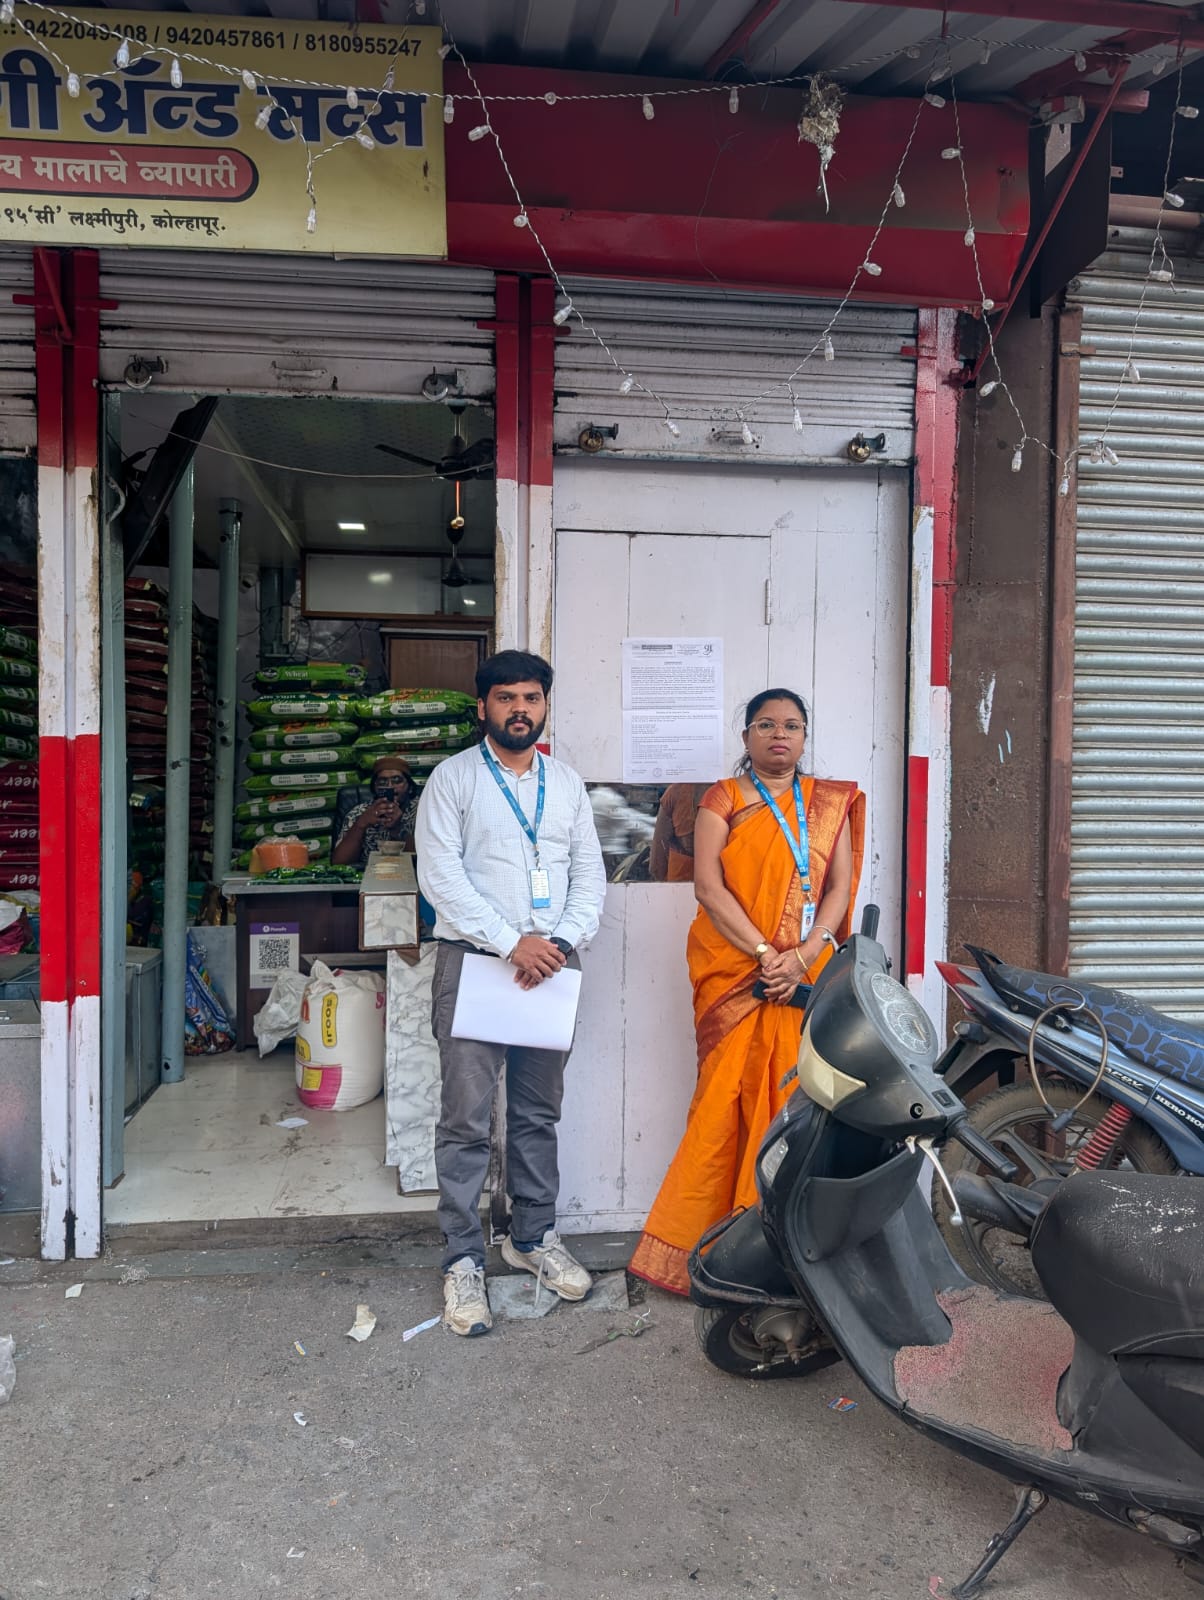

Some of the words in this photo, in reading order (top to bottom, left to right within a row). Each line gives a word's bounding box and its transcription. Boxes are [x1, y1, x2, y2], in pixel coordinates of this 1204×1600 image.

[24, 20, 147, 42] 9422049408
[154, 26, 160, 43] /
[166, 27, 285, 48] 9420457861
[293, 33, 299, 50] /
[305, 34, 422, 57] 8180955247
[31, 150, 128, 184] मालाचे
[137, 155, 237, 188] व्यापारी
[68, 208, 145, 234] लक्ष्मीपुरी,
[151, 209, 226, 237] कोल्हापूर.
[10, 829, 40, 840] eer
[10, 874, 40, 886] eer
